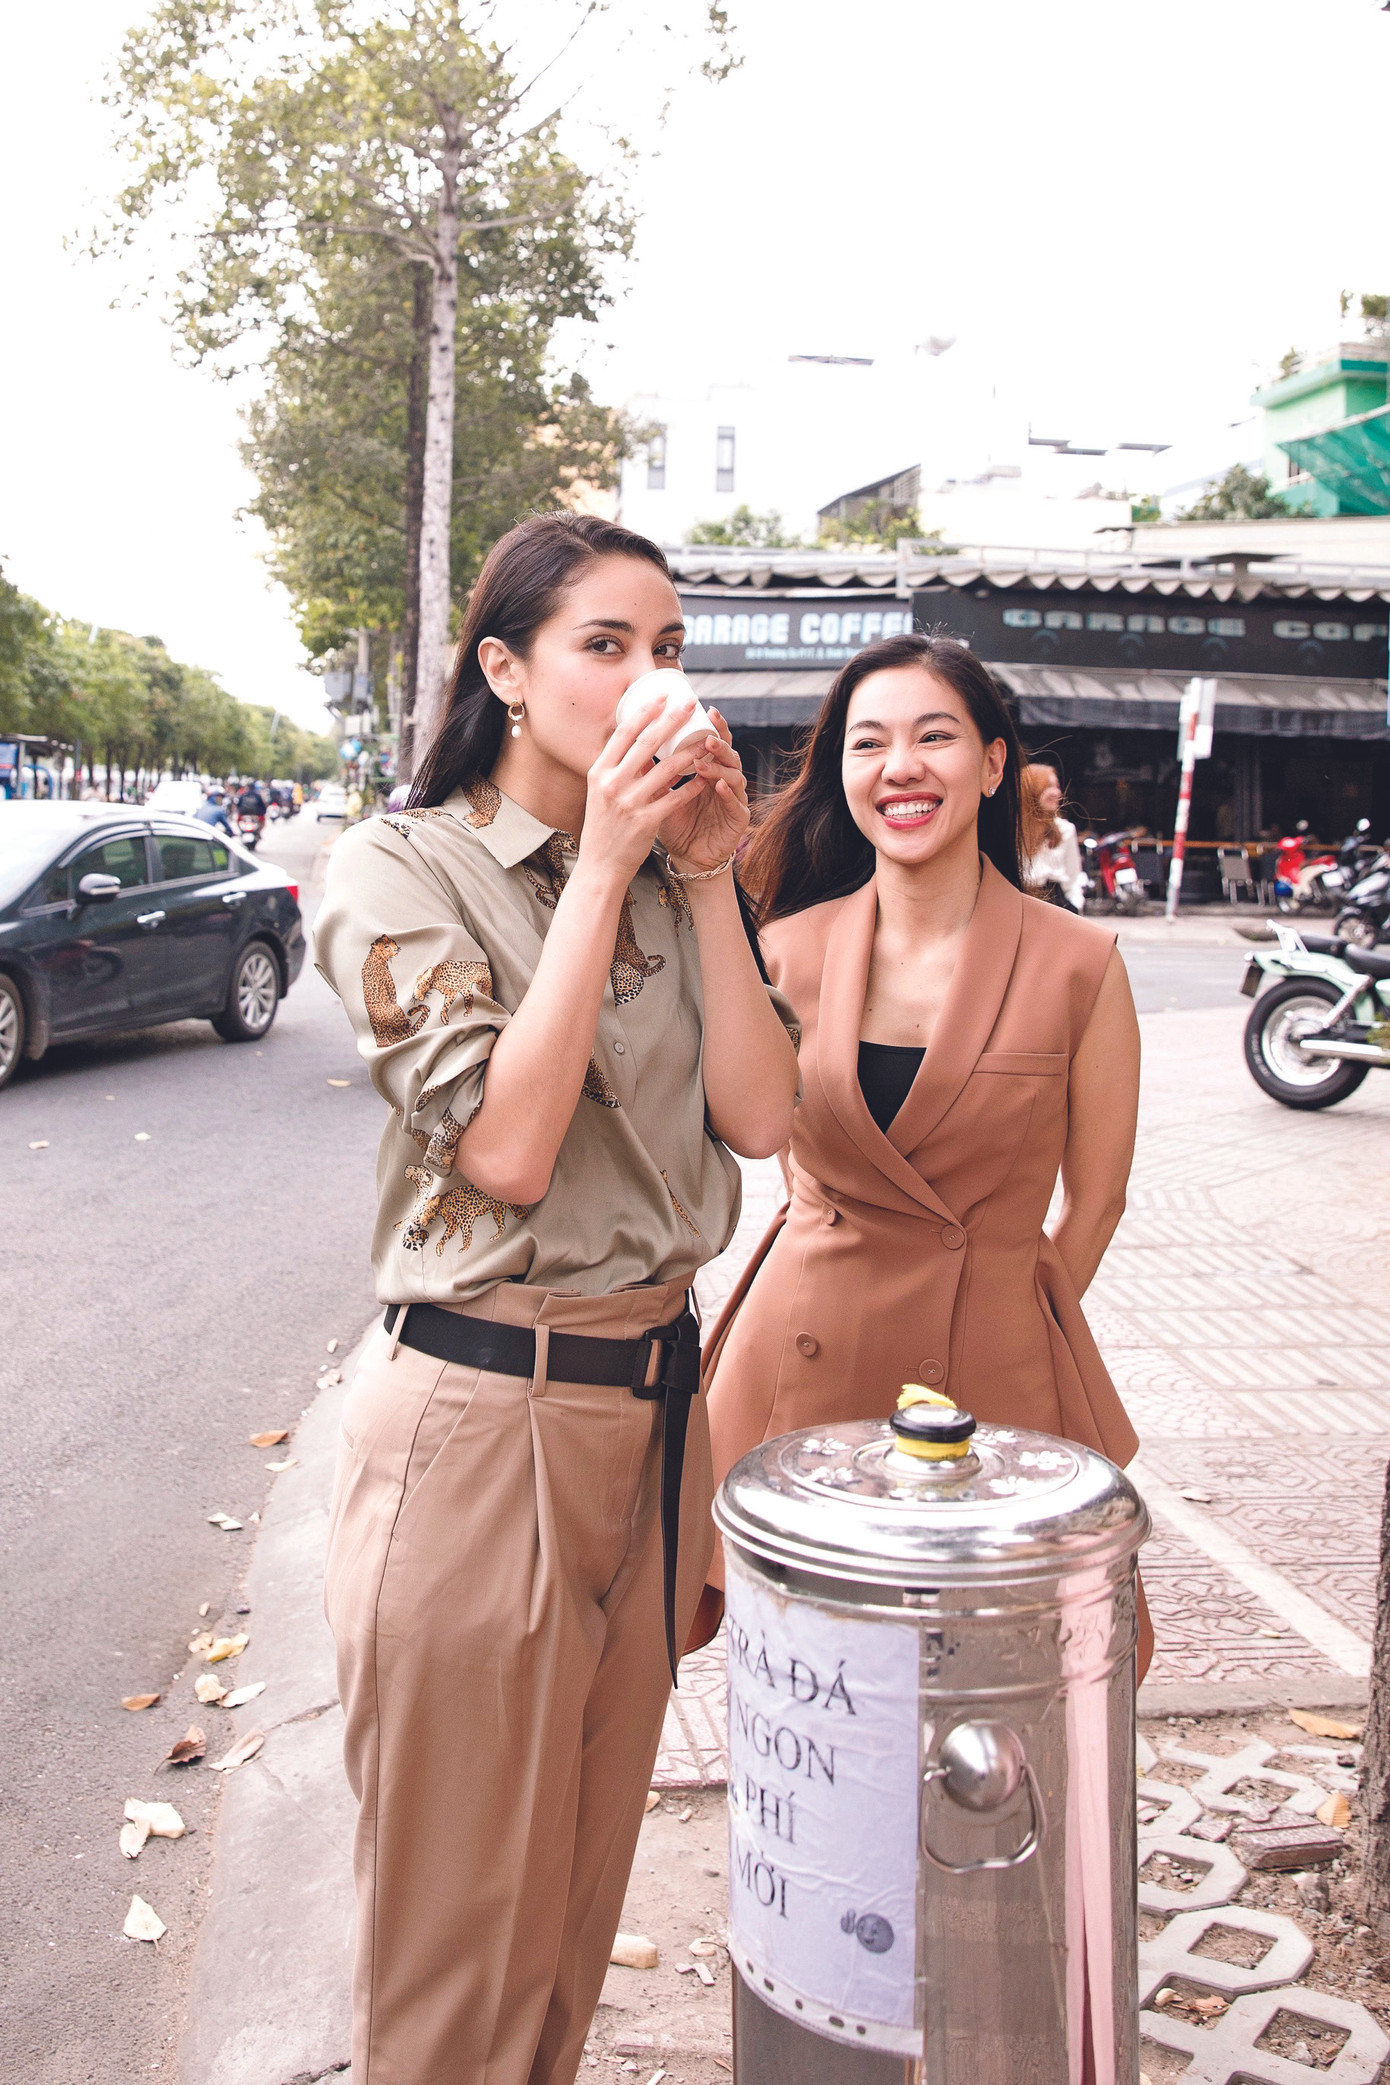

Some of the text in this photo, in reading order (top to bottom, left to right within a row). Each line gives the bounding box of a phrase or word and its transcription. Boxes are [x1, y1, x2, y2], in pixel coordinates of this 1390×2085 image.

[1002, 607, 1246, 638] GARAGE
[729, 1613, 858, 1717] TRÀ ĐÁ
[735, 1691, 836, 1786] NGON
[745, 1773, 796, 1846] PHÍ
